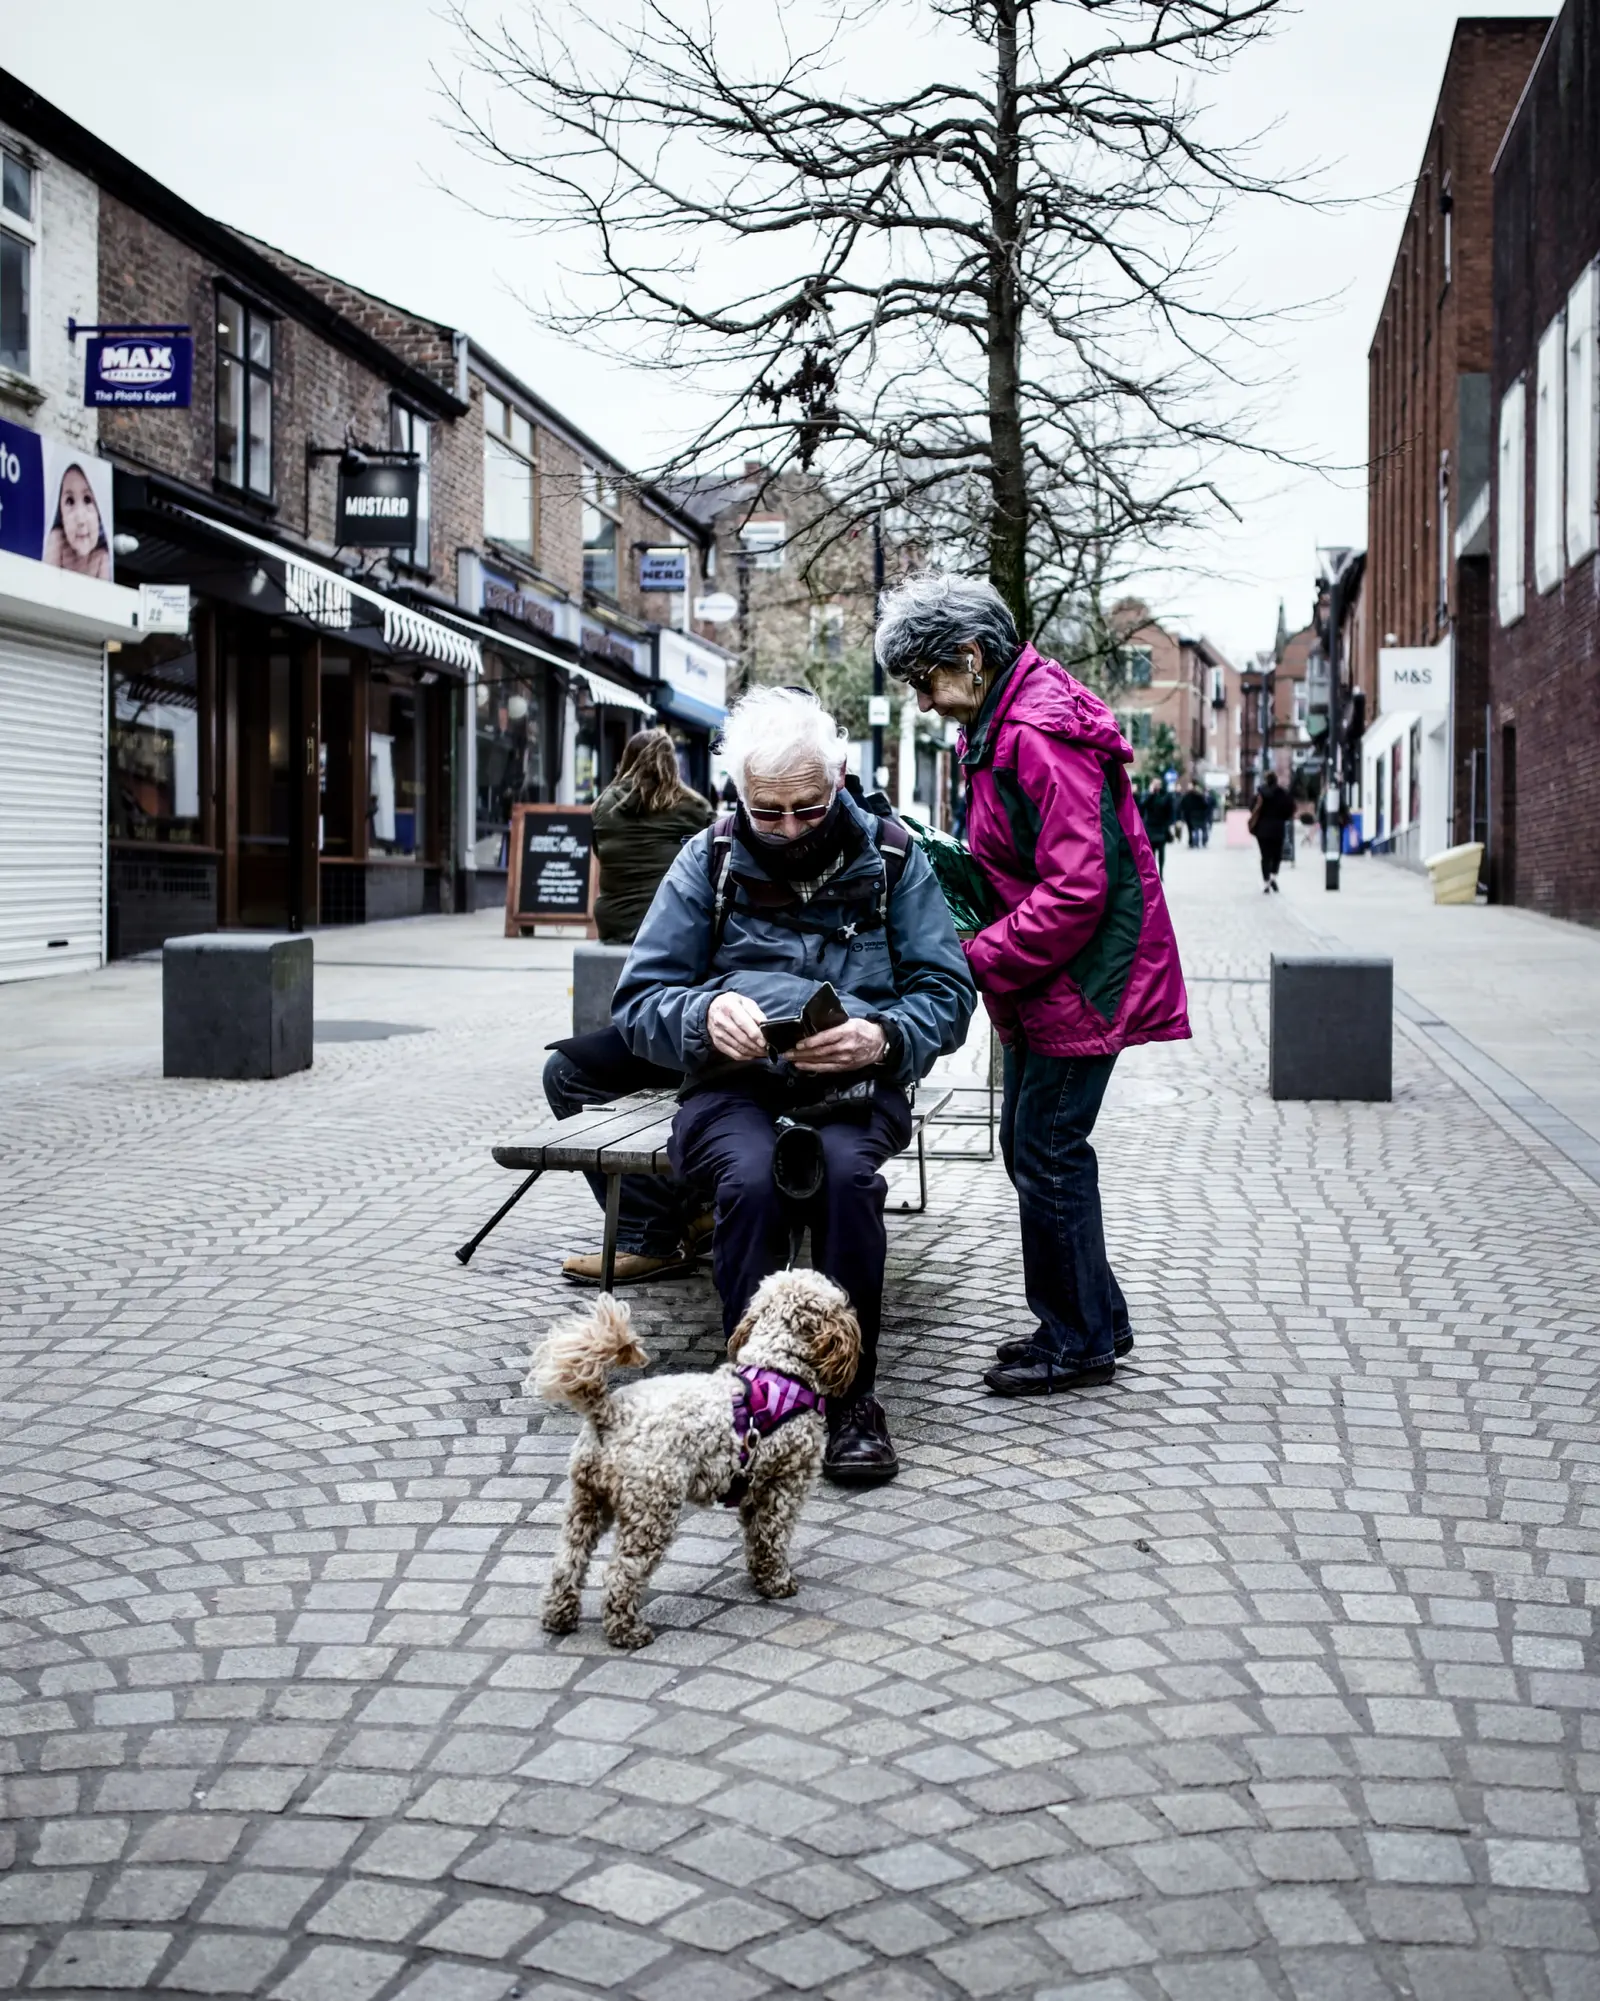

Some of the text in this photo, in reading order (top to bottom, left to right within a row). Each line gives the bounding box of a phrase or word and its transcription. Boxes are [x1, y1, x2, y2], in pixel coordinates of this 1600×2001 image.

[102, 346, 172, 369] MAX
[94, 389, 177, 403] The Photo Expert
[345, 496, 409, 517] MUSTARD
[642, 570, 685, 580] NERO
[285, 562, 352, 629] MUSTARD
[1394, 668, 1432, 685] M&S
